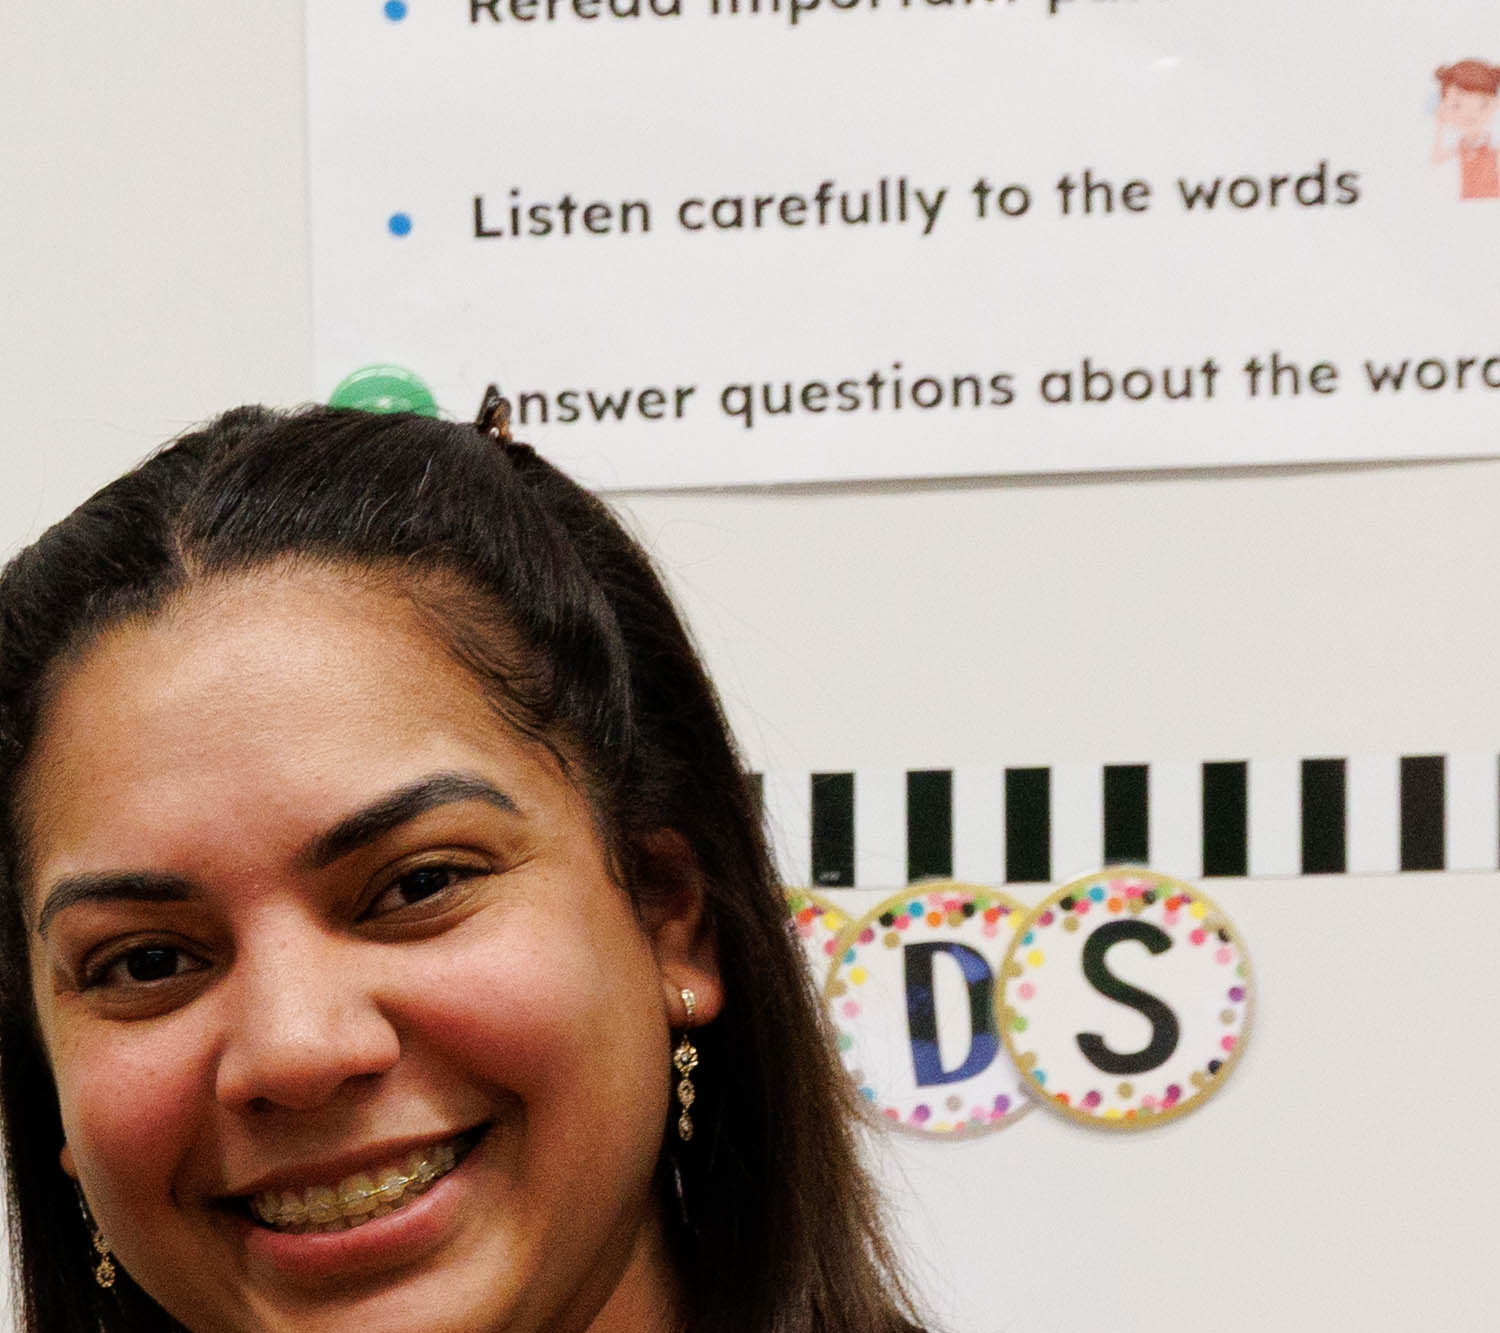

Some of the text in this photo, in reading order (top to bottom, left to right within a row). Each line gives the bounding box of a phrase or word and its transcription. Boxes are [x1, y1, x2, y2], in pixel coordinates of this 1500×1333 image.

[472, 159, 1362, 239] Listen carefully to the words
[720, 363, 1015, 430] questions
[1038, 357, 1218, 407] about
[1243, 351, 1340, 397] the
